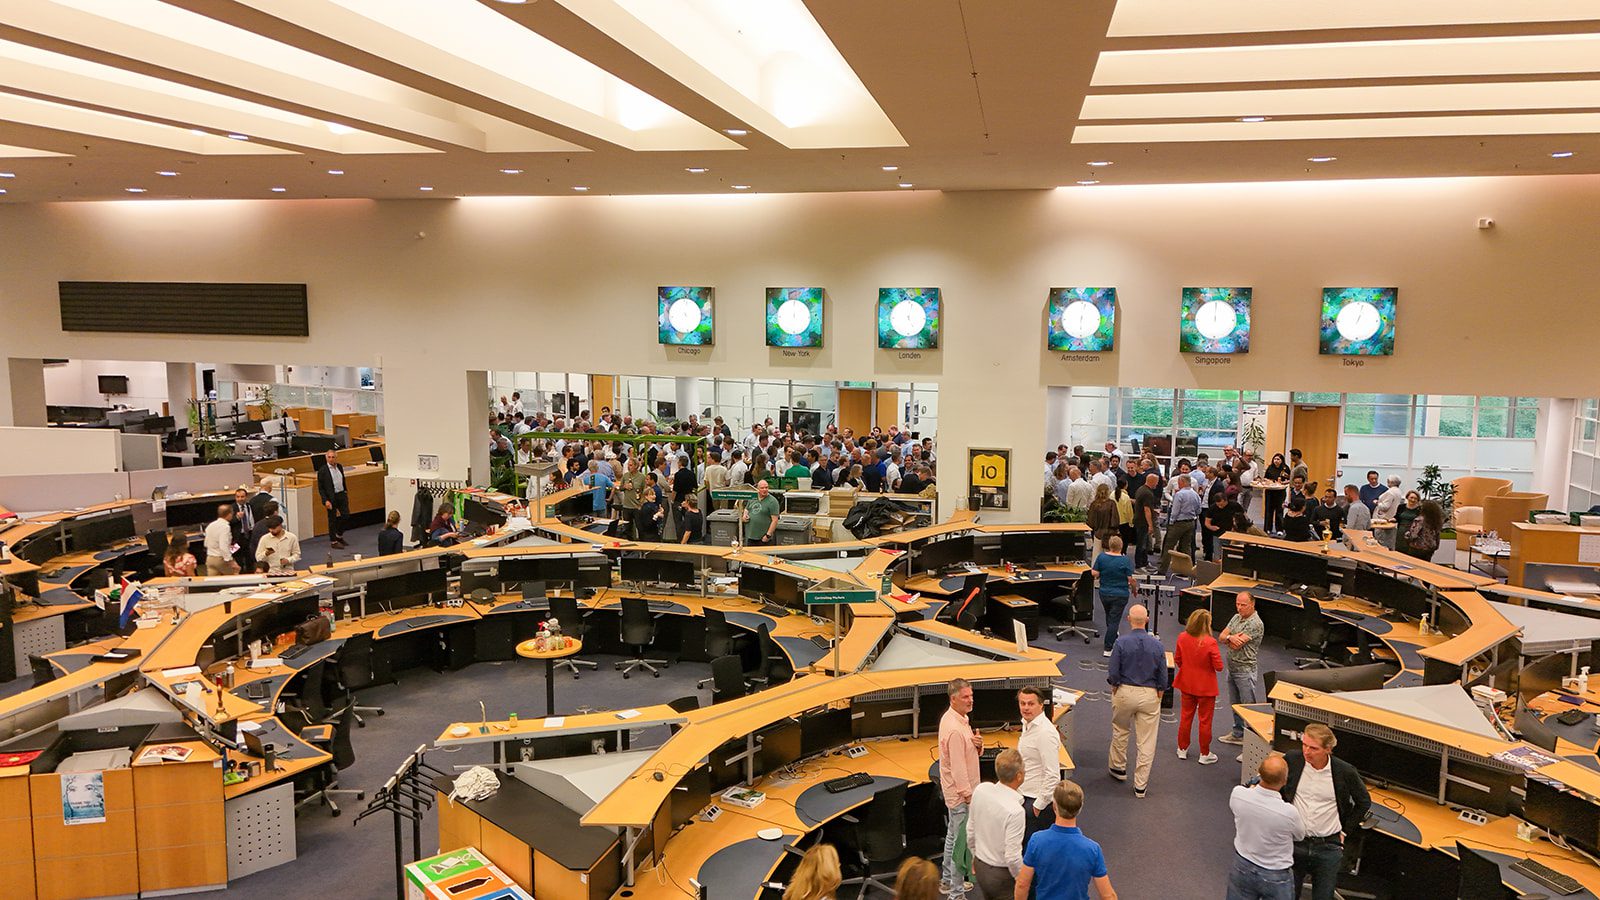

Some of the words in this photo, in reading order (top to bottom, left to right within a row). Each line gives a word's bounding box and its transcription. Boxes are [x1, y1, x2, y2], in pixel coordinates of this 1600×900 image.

[678, 346, 702, 356] Chicago
[797, 350, 811, 358] York
[1060, 354, 1101, 362] Amsterdam
[1194, 355, 1232, 366] Singapore
[1342, 358, 1365, 368] Tokyo
[980, 464, 998, 480] 10
